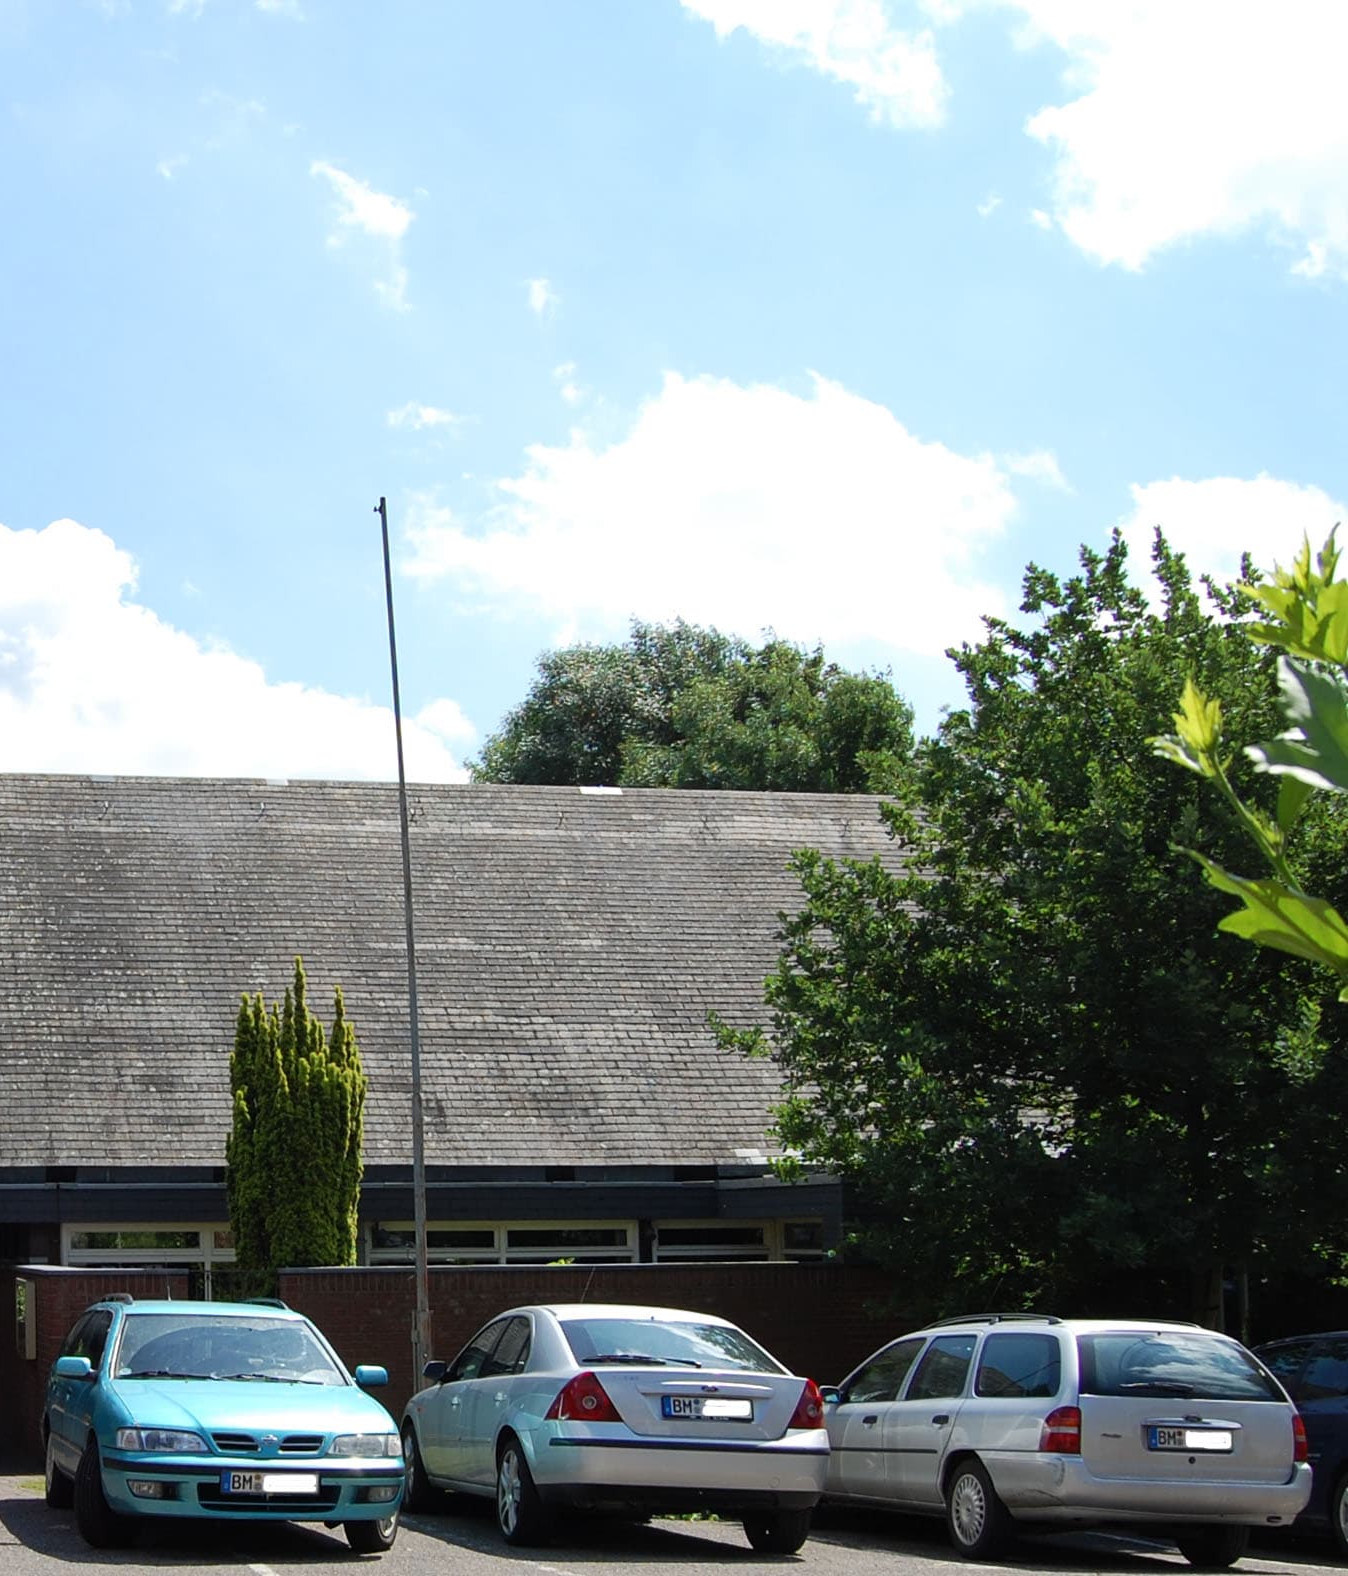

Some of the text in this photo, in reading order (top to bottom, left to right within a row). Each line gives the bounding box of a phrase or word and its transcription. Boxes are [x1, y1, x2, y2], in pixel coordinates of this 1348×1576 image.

[673, 1399, 692, 1414] BM
[1158, 1430, 1176, 1445] BM
[232, 1474, 252, 1490] BM
